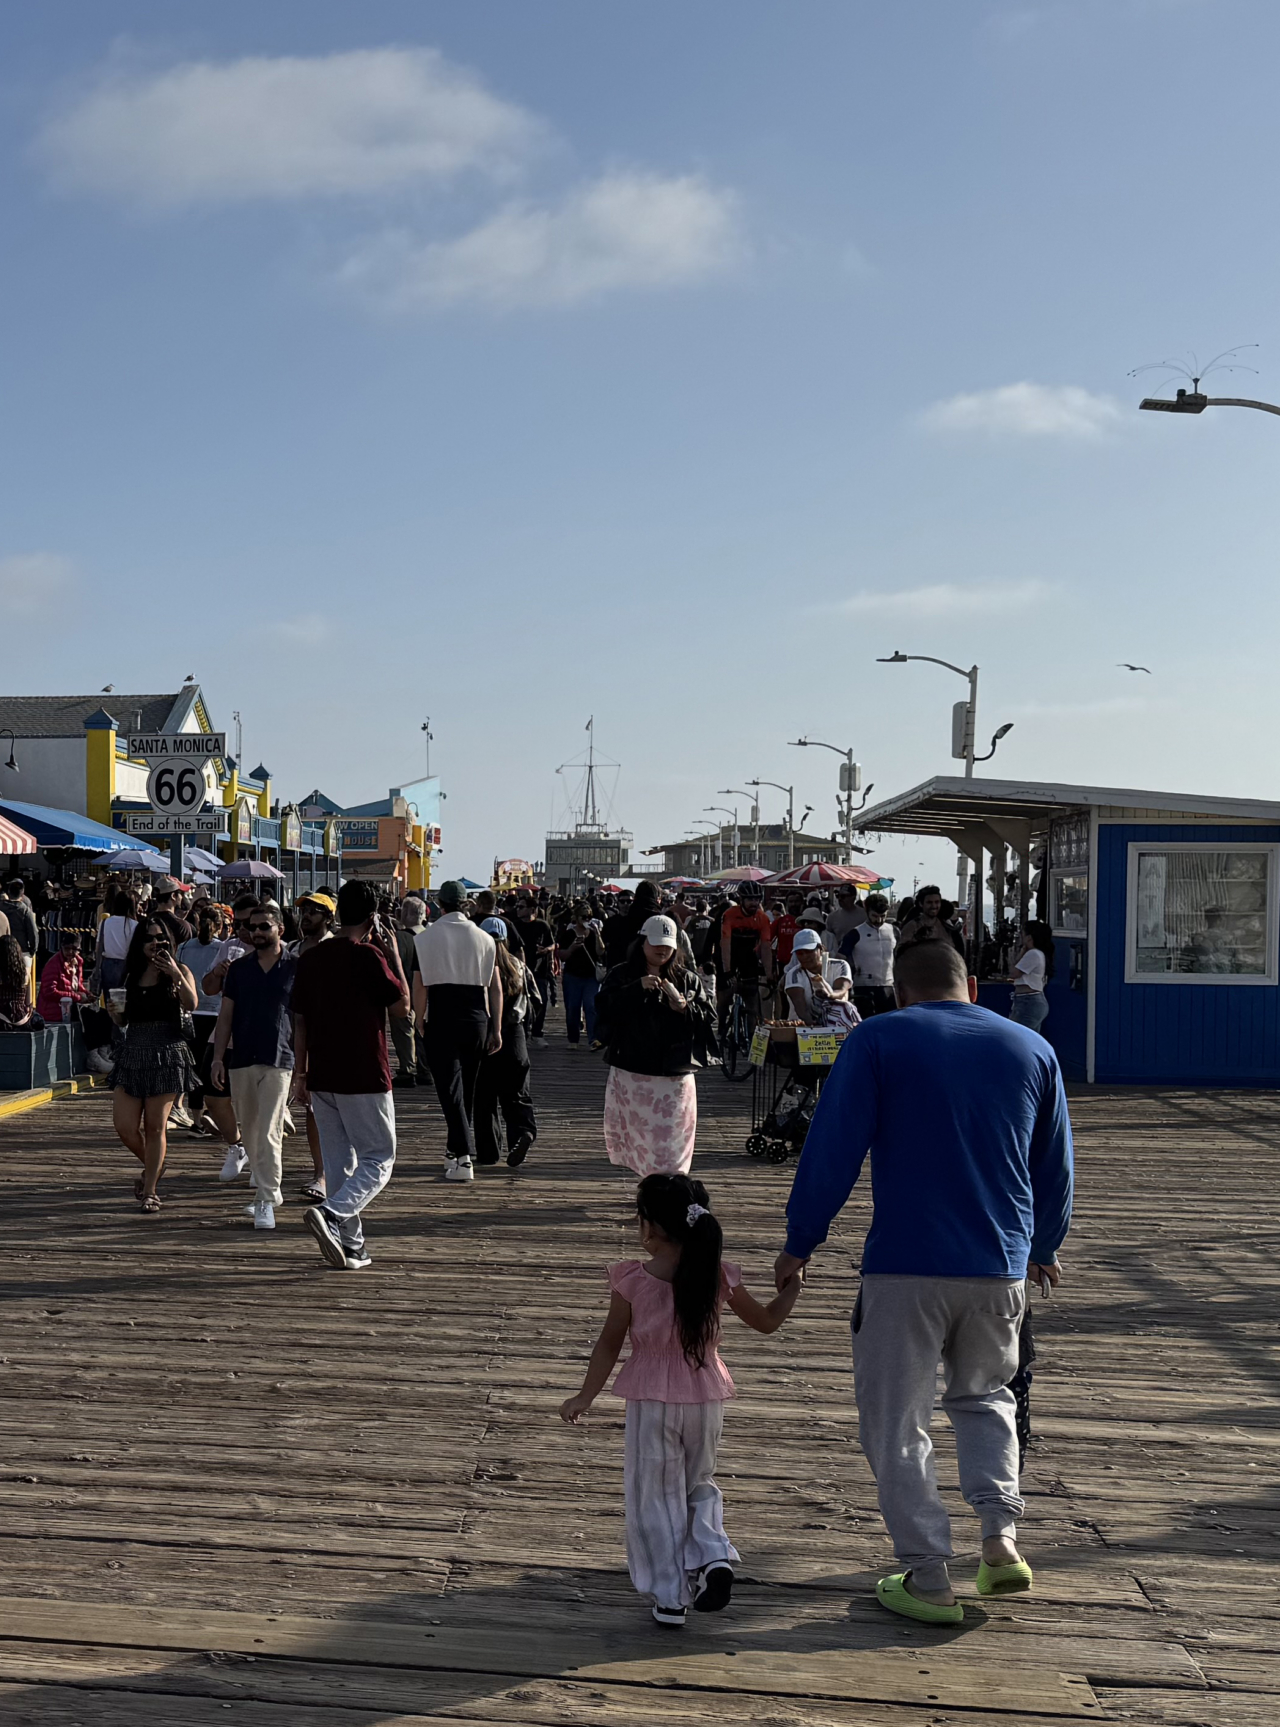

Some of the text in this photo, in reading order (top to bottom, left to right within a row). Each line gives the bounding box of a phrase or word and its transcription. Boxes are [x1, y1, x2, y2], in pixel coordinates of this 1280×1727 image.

[131, 738, 221, 753] SANTA MONICA
[155, 768, 197, 806] 66
[132, 817, 154, 830] End
[158, 817, 170, 830] of
[173, 817, 191, 830] the
[195, 817, 220, 830] Trail
[350, 821, 378, 830] OPEN
[343, 836, 378, 845] HOUSE
[1143, 862, 1161, 939] ATM
